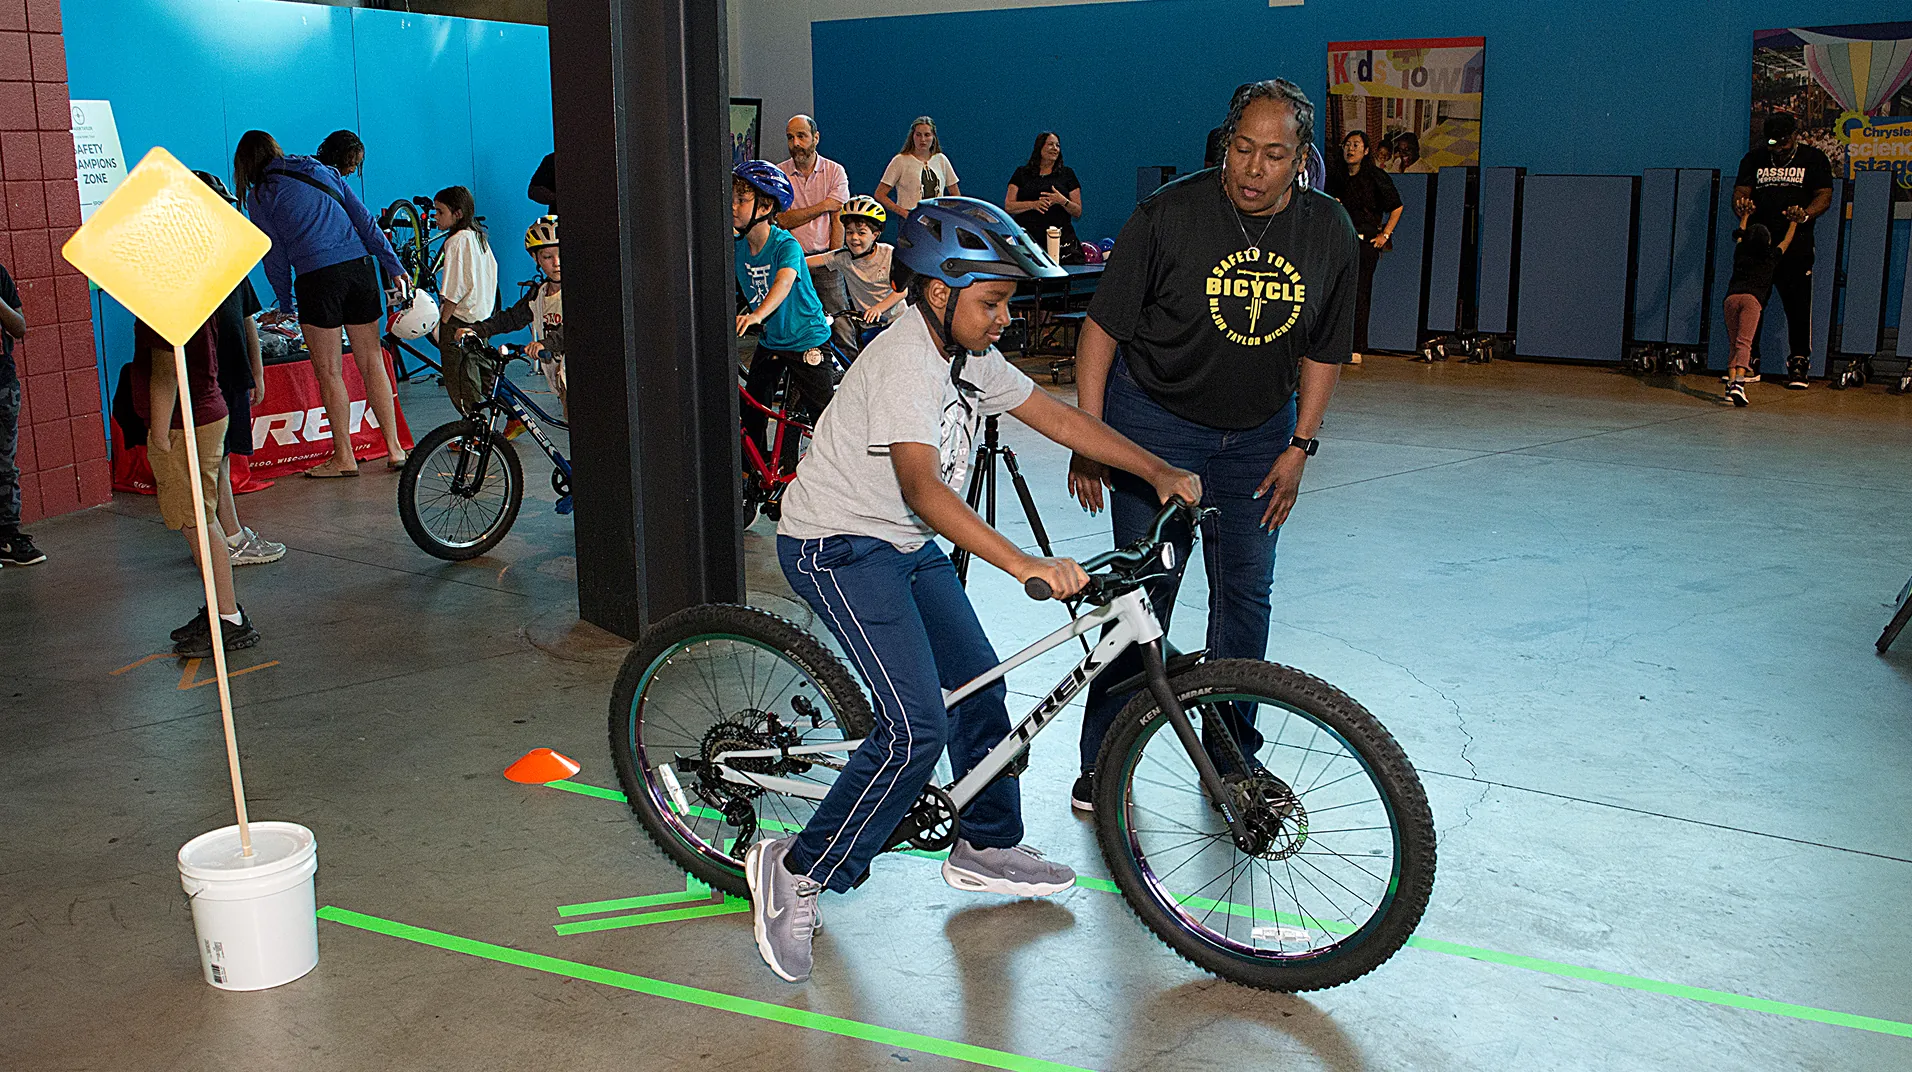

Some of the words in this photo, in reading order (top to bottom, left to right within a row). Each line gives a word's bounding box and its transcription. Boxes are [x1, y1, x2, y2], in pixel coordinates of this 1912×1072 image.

[1333, 50, 1387, 85] Kids
[1393, 50, 1483, 94] Town
[1862, 126, 1912, 139] Chrysle
[1847, 138, 1912, 157] scienc
[77, 158, 117, 170] AMPIONS
[1757, 167, 1805, 178] PASSION
[83, 173, 108, 184] ZONE
[1757, 175, 1803, 184] PERFORMANCE
[1212, 250, 1260, 278] SAFETY
[1267, 251, 1302, 284] TOWN
[1205, 277, 1306, 303] BICYCLE
[1209, 298, 1228, 331] MAJOR
[1226, 329, 1261, 346] TAYLOR
[1264, 304, 1302, 344] MICHIGAN
[250, 395, 398, 450] REK
[512, 404, 558, 457] TREK
[784, 649, 818, 677] KENDA
[1009, 650, 1102, 743] TREK
[1140, 706, 1161, 726] KEN
